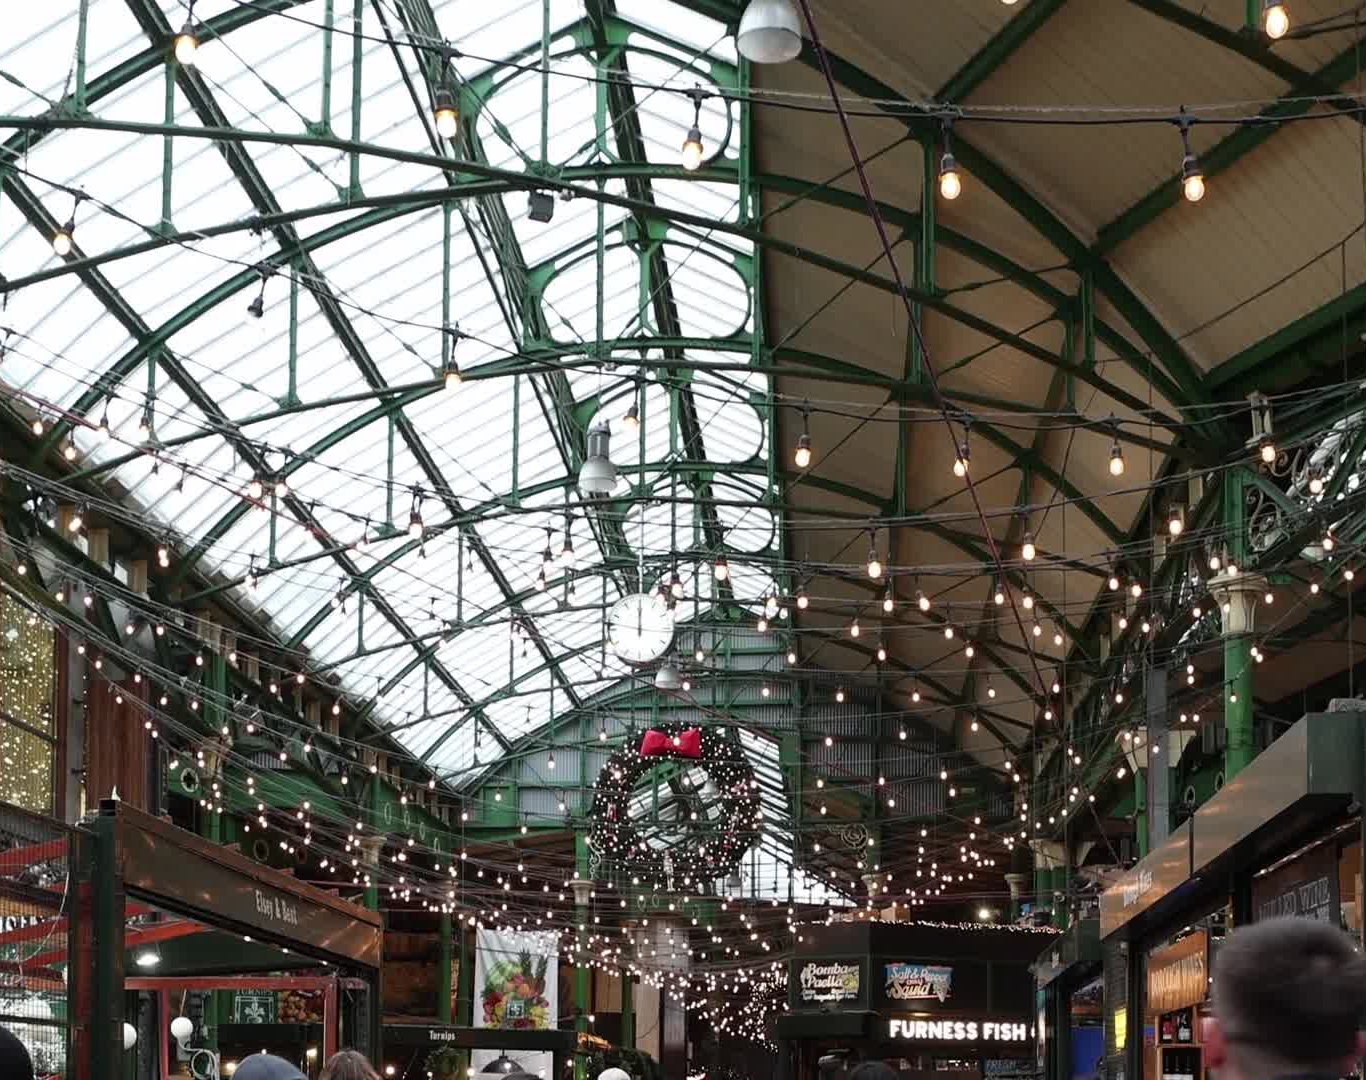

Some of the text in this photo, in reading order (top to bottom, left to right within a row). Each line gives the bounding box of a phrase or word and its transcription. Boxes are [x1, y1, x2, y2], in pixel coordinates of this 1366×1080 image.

[808, 963, 848, 975] Bomba
[807, 976, 842, 988] Paella
[891, 980, 931, 999] Squid
[429, 1030, 455, 1042] Turnips
[889, 1020, 978, 1040] FURNESS
[983, 1022, 1026, 1041] FISH
